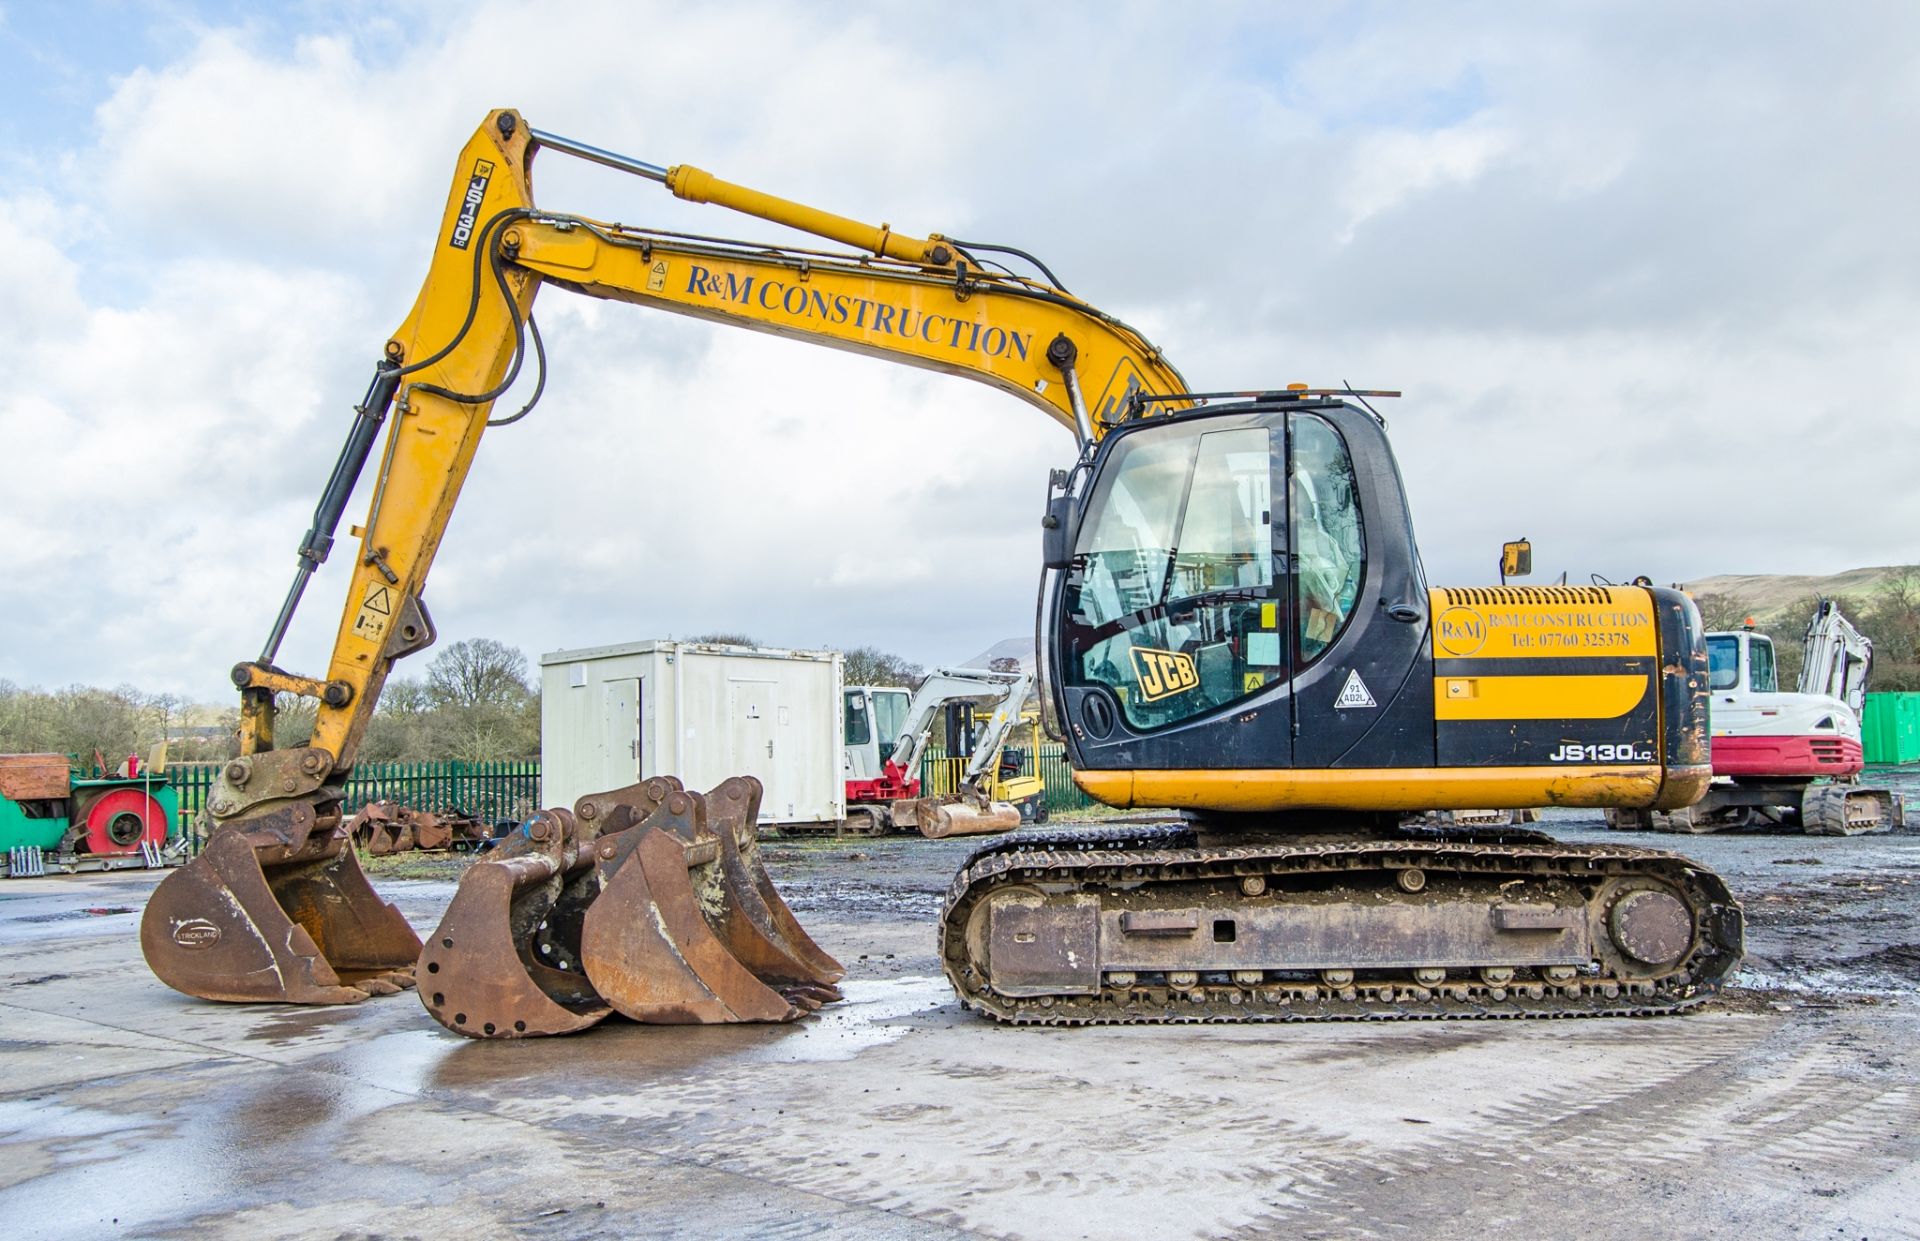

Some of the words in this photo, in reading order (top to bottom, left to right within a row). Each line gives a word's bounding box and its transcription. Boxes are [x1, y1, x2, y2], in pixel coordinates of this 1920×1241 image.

[686, 265, 755, 305] R&M
[759, 281, 1032, 362] CONSTRUCTION
[1489, 613, 1519, 627] R&M
[1522, 612, 1648, 628] CONSTRUCTION
[1442, 621, 1480, 639] R&M
[1511, 633, 1535, 647] Tel:
[1539, 633, 1578, 647] 07760
[1583, 632, 1630, 647] 325378
[1141, 652, 1194, 696] JCB
[1349, 685, 1360, 693] 91
